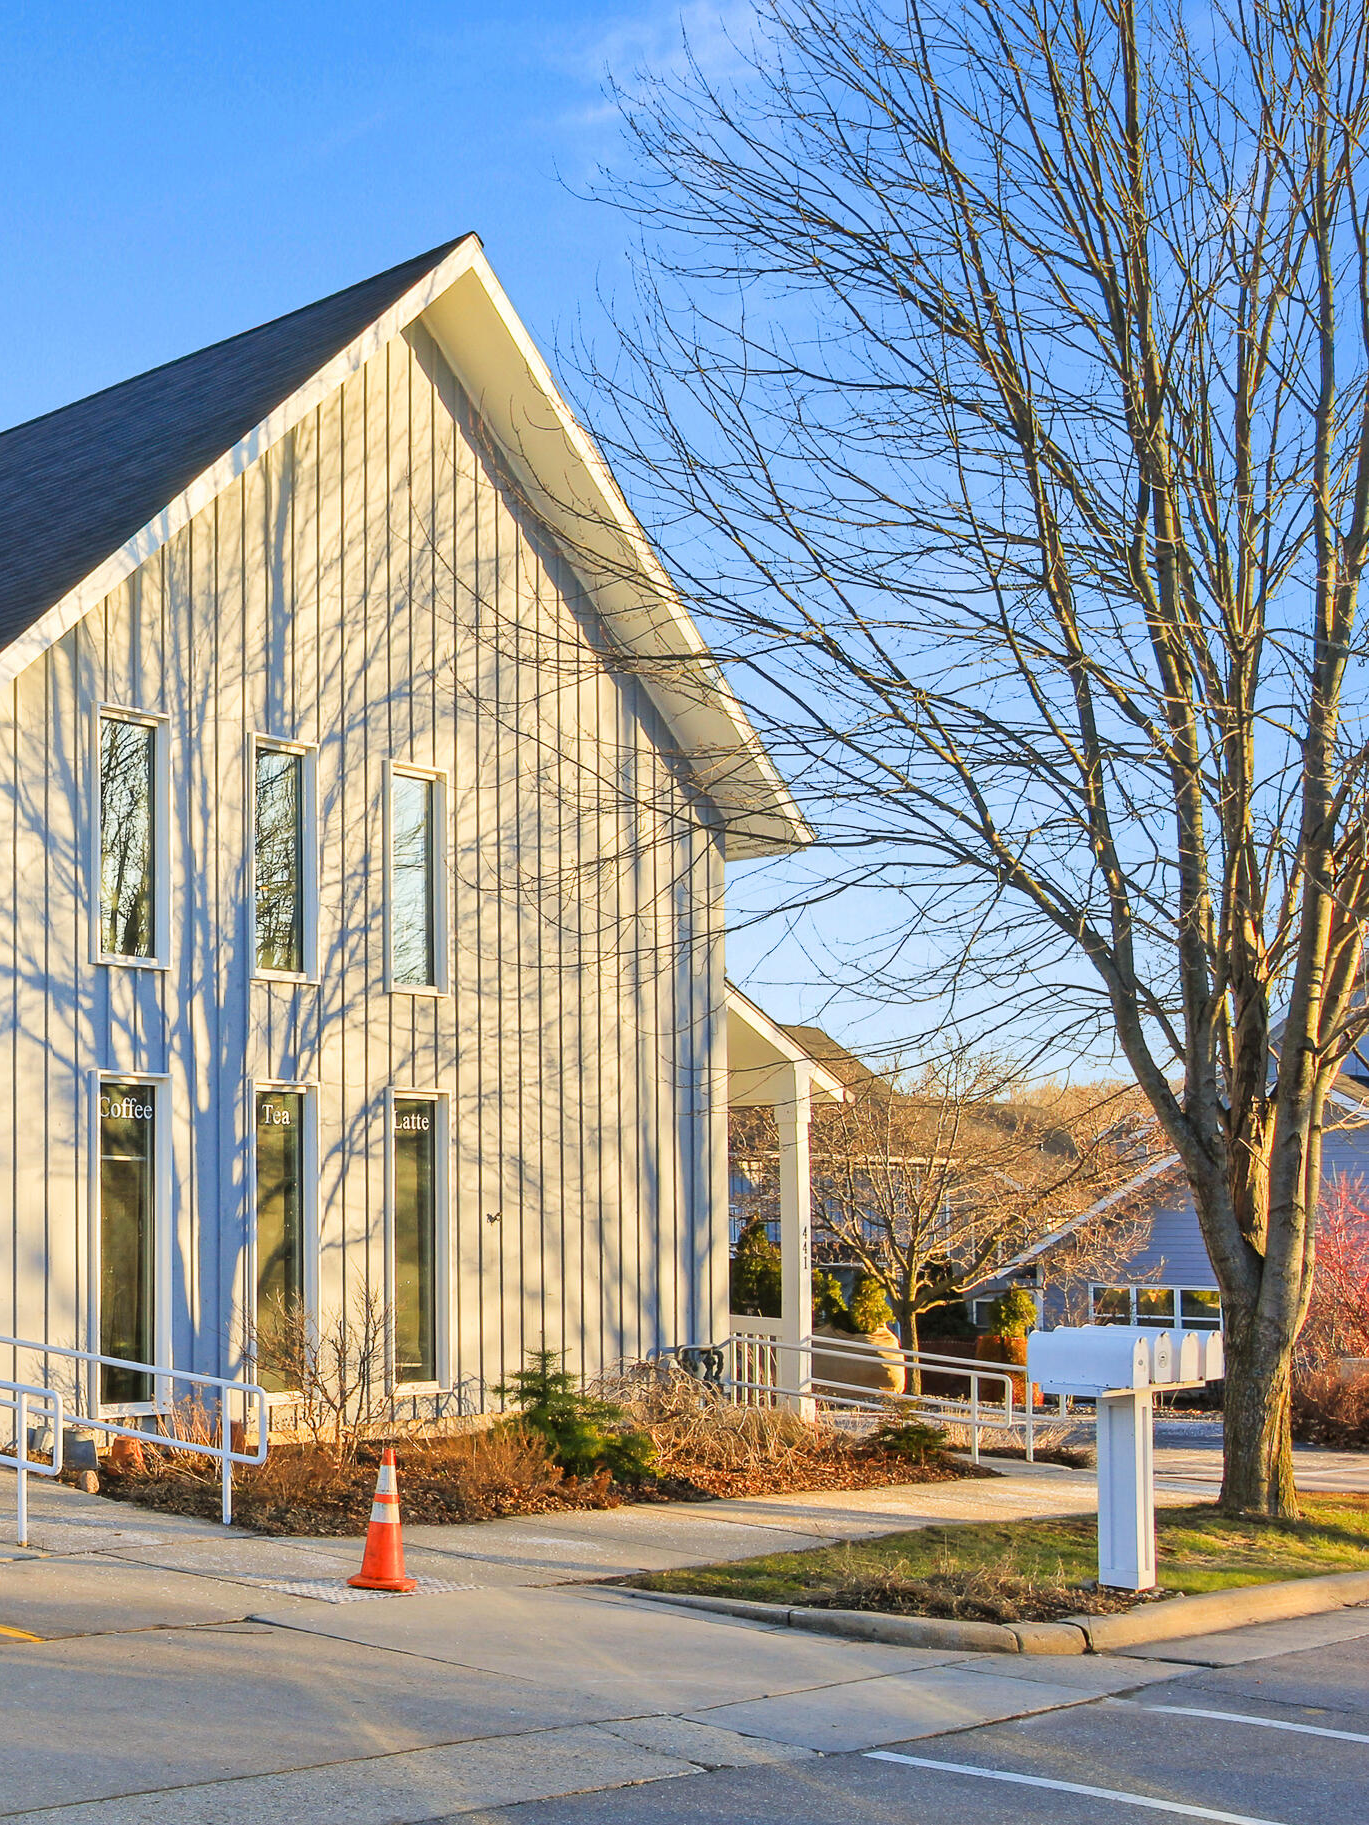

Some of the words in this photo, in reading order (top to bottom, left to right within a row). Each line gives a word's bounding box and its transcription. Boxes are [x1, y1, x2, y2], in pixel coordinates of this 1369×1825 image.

[100, 1096, 153, 1119] Coffee
[262, 1104, 291, 1125] Tea
[394, 1109, 430, 1131] Latte
